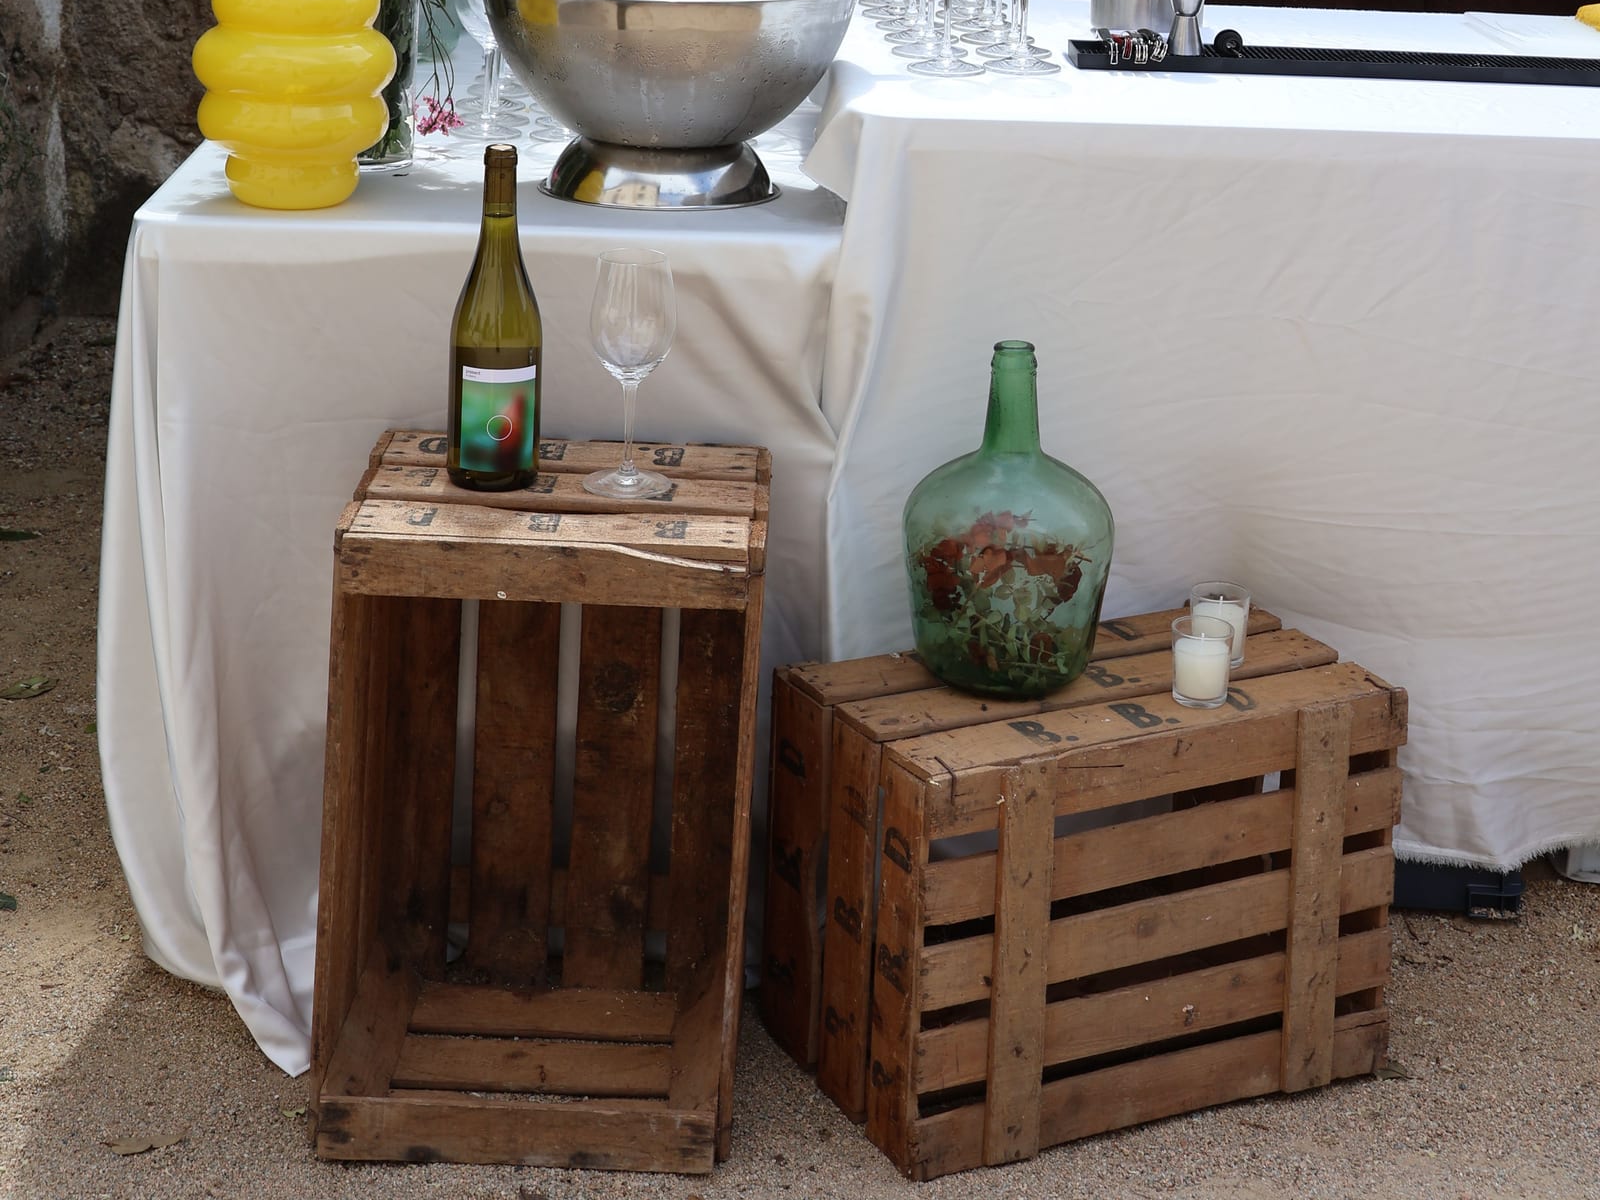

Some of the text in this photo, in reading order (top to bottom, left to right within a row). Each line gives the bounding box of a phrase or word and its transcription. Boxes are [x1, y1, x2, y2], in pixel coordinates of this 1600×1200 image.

[1085, 664, 1142, 688] B.
[1007, 719, 1079, 744] B.
[1108, 702, 1182, 728] B.
[884, 826, 913, 874] D
